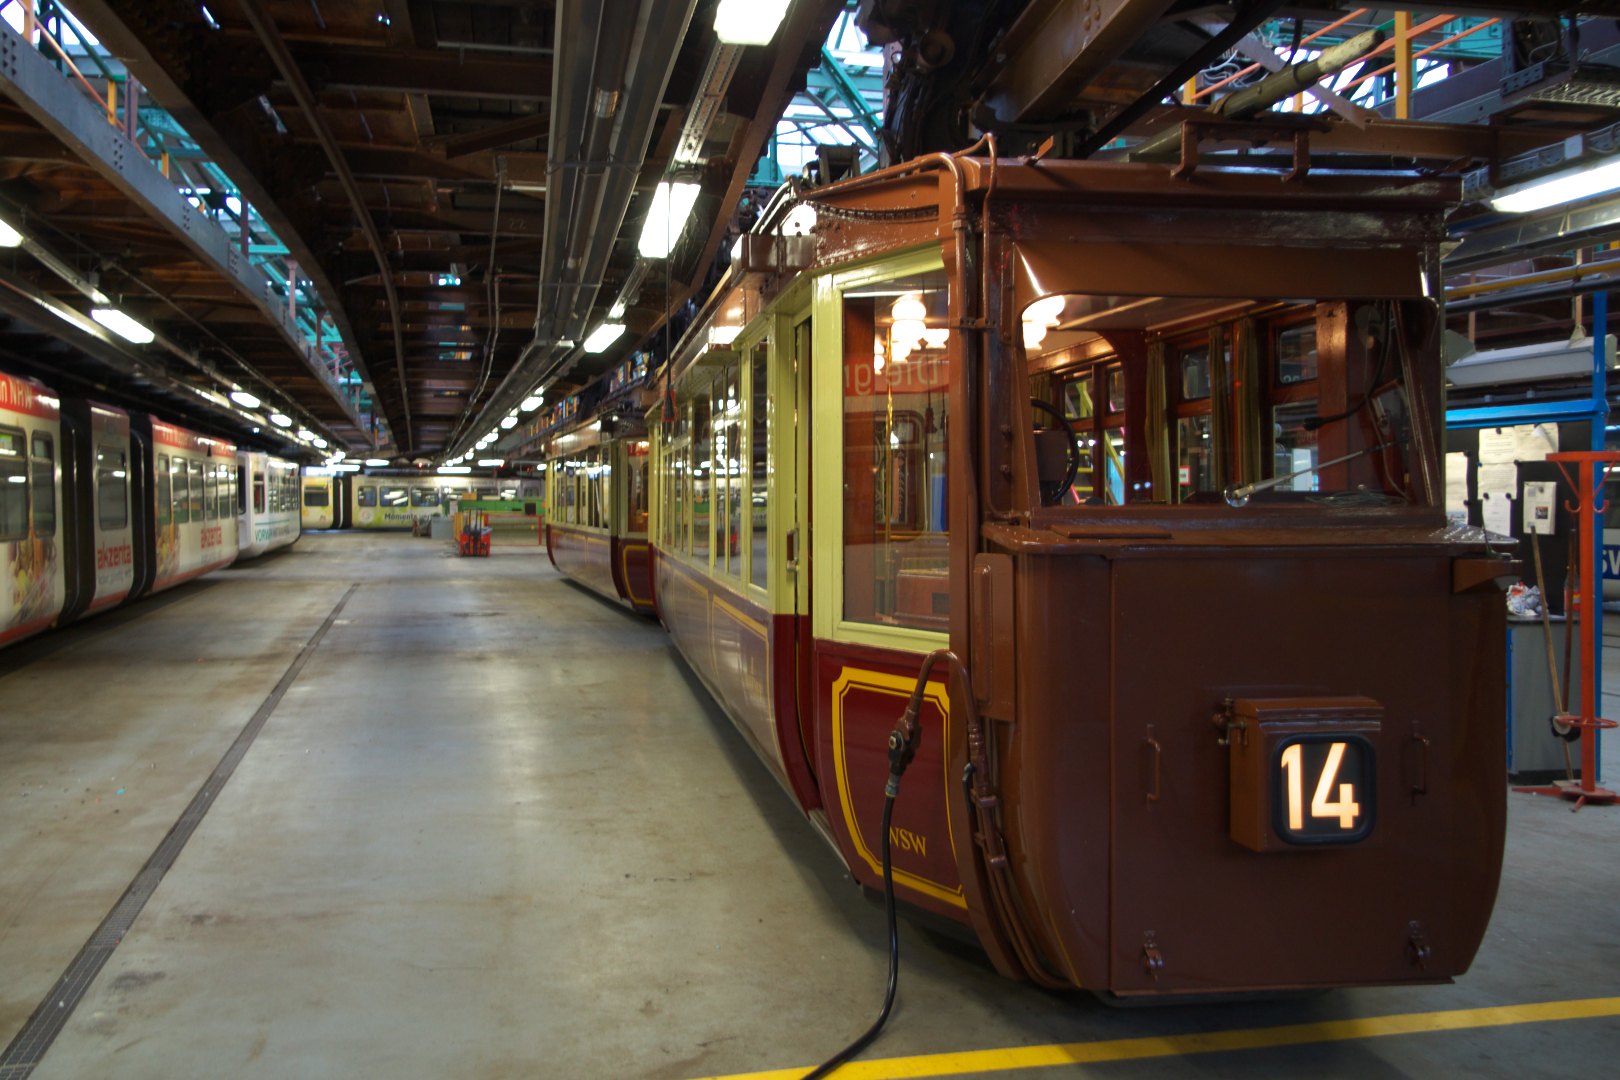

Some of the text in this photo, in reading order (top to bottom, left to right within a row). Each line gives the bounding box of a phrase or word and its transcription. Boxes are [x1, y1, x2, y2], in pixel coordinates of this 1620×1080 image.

[8, 376, 32, 409] NRW
[97, 538, 132, 570] akzenta
[1281, 742, 1360, 831] 14
